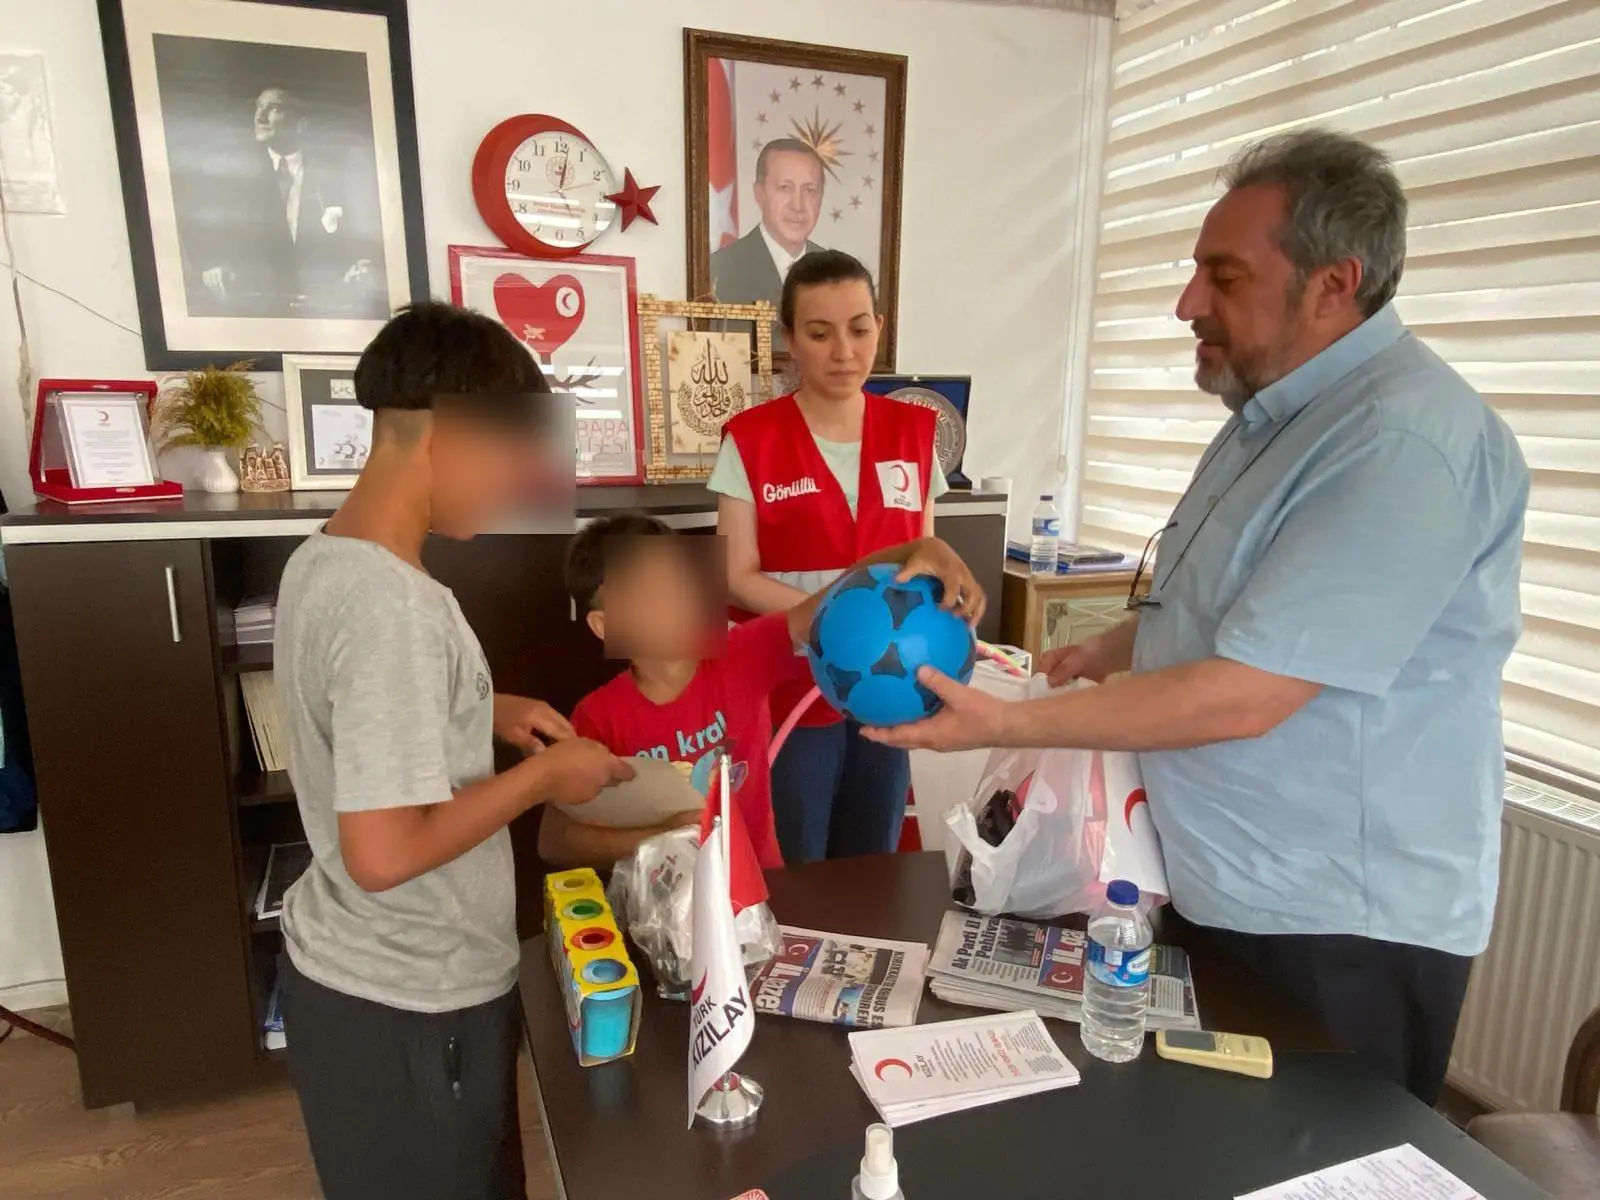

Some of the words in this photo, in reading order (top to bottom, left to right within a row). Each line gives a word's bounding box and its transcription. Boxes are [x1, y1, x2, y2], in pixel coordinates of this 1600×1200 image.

[554, 141, 568, 154] 12
[519, 160, 531, 172] 10
[593, 171, 601, 181] 2
[512, 179, 520, 191] 9
[555, 229, 564, 241] 6
[577, 419, 630, 438] BABA
[763, 476, 823, 503] Gönüllü
[676, 710, 727, 757] kral
[957, 931, 978, 956] Parti
[952, 957, 969, 970] Ak
[693, 996, 717, 1028] TÜRK
[692, 985, 747, 1071] KIZILAY
